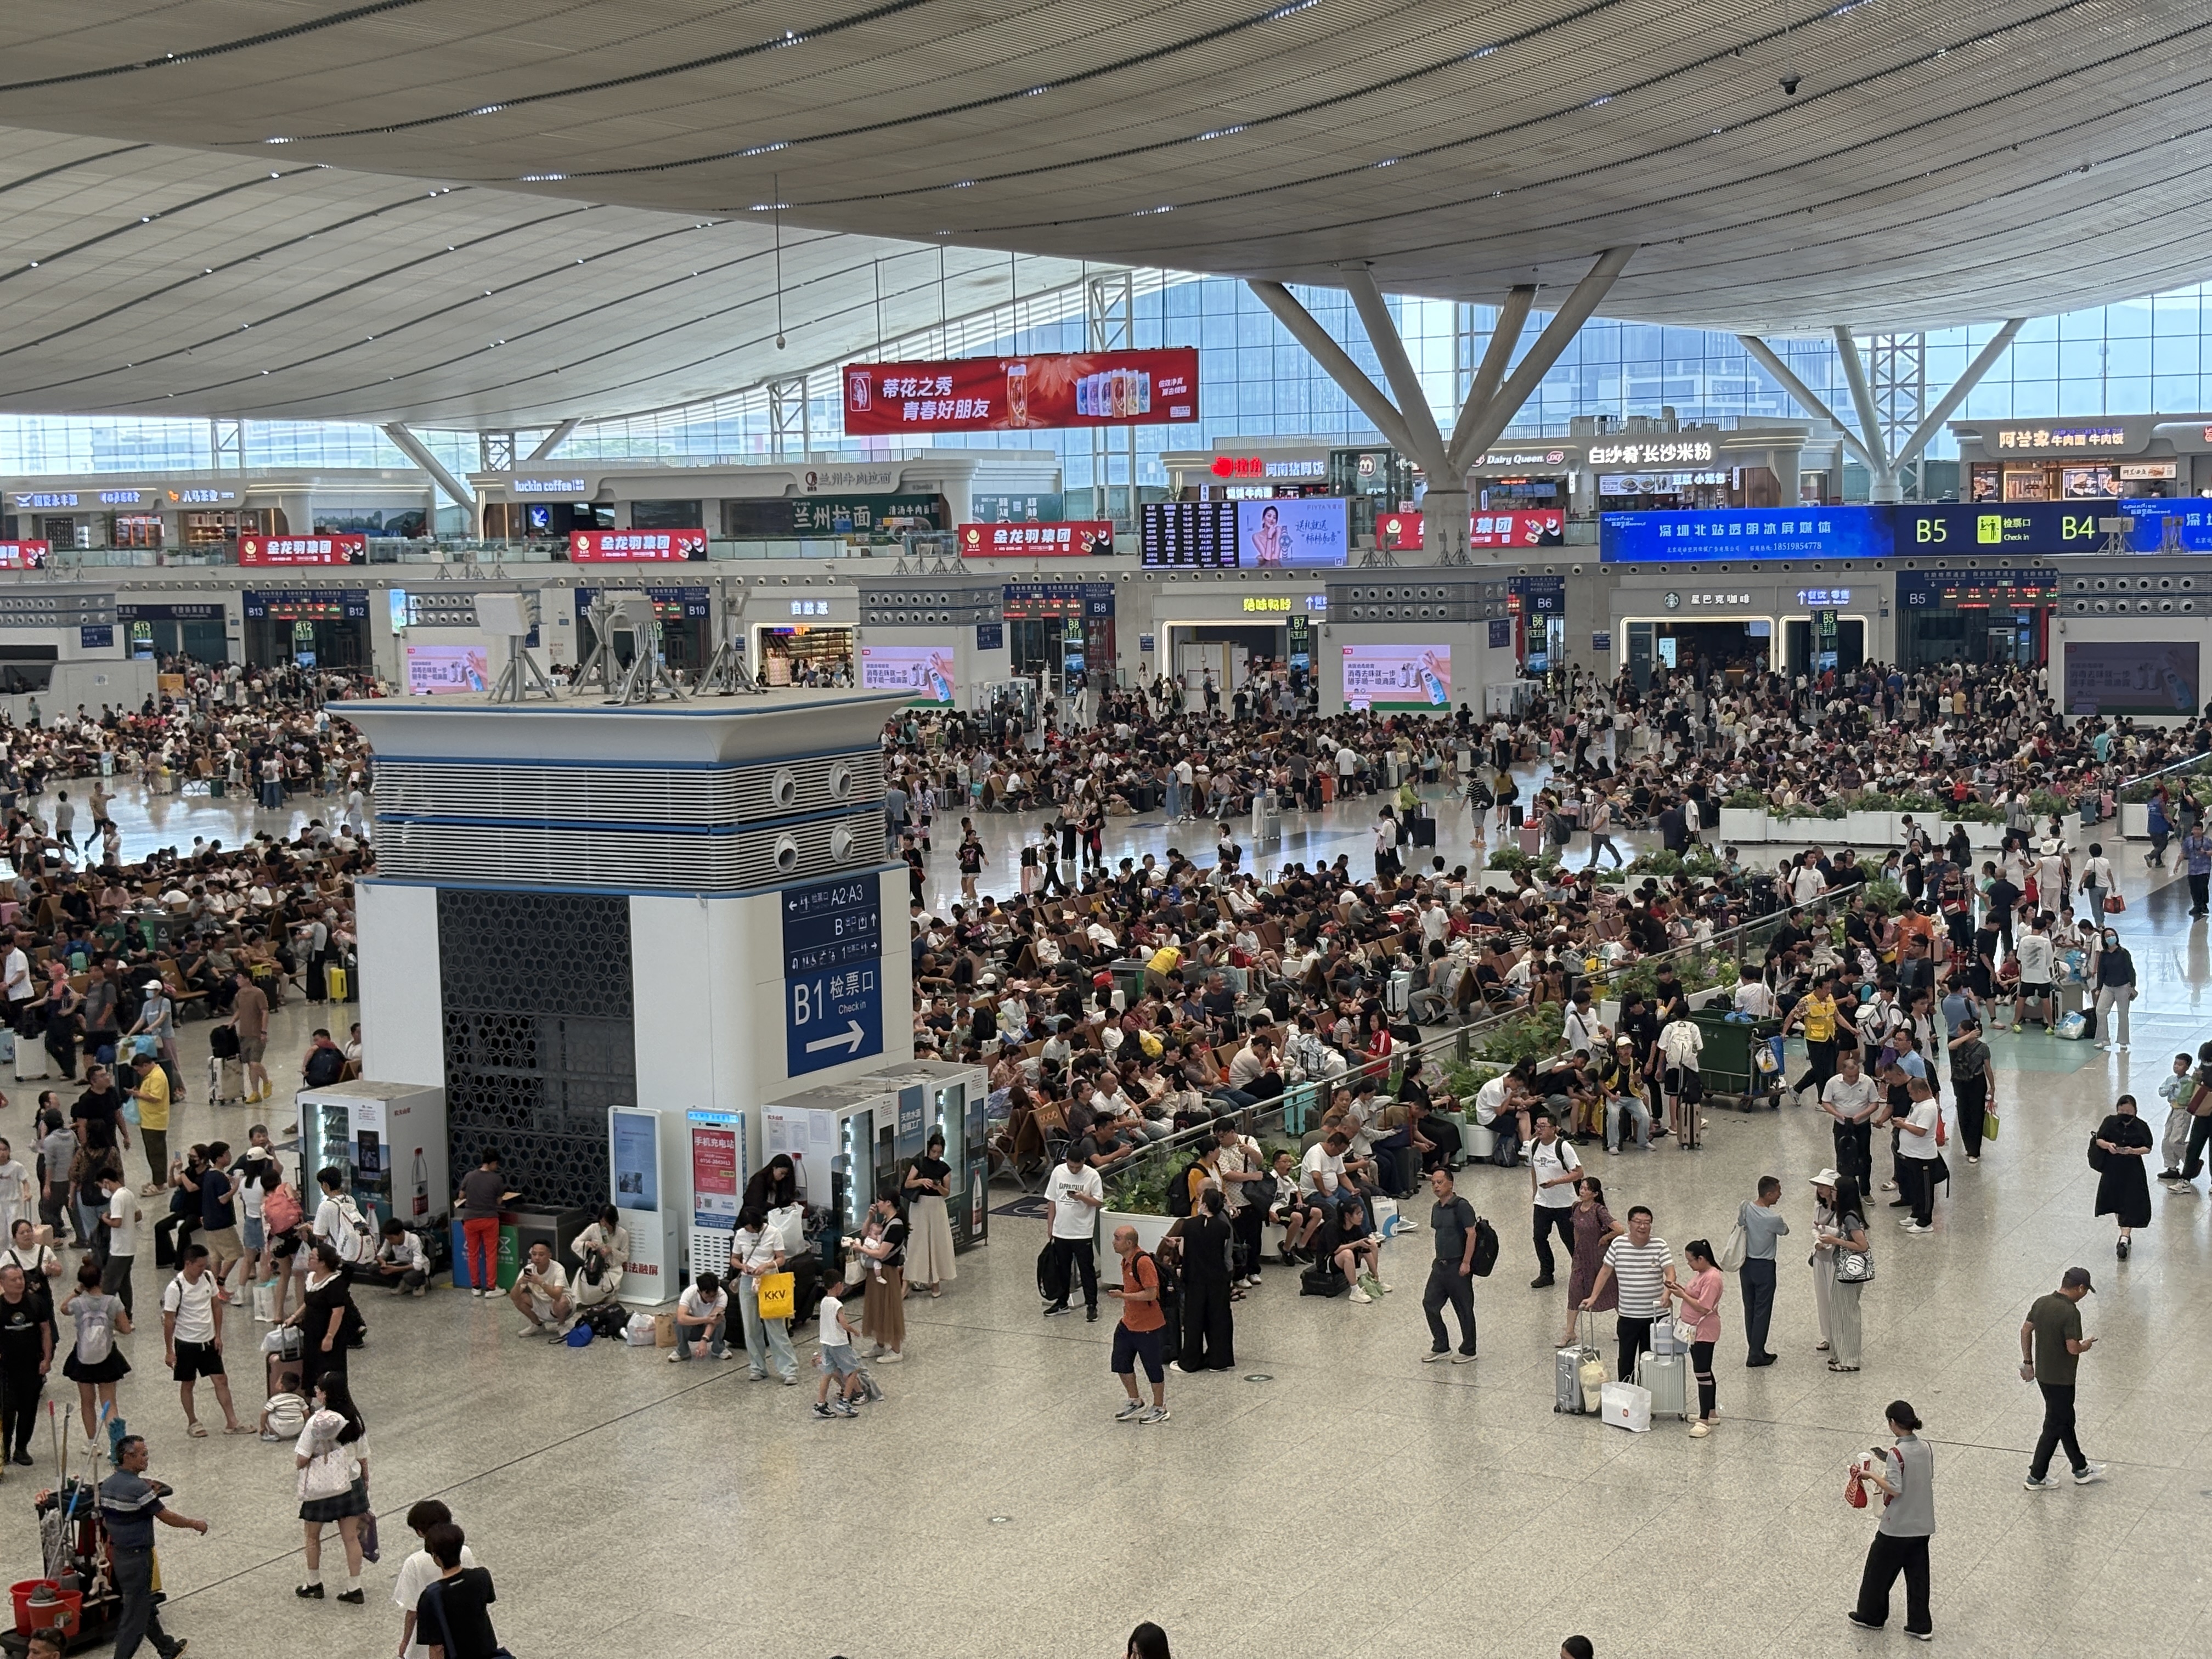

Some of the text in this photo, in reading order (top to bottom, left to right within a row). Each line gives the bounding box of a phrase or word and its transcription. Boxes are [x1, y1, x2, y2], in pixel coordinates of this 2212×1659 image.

[883, 376, 953, 399] 蒂花之秀
[903, 398, 991, 421] 青春好朋友
[1642, 442, 1711, 462] 长沙米粉
[1487, 455, 1543, 465] Dairy Queen
[819, 471, 891, 487] 兰州牛肉拉面
[514, 479, 572, 492] luckin coffee
[2004, 517, 2031, 528] 检票口
[2062, 516, 2096, 540] B4
[1659, 521, 1831, 537] 深圳北站透明冰屏媒体
[1916, 519, 1947, 543] B5
[994, 528, 1071, 544] 金龙羽集团
[2004, 533, 2030, 541] Check in
[267, 540, 332, 555] 金龙羽集团
[601, 535, 671, 550] 金龙羽集团
[1774, 541, 1822, 551] 18519854778
[1243, 597, 1291, 612] 绝味鸭脖
[1538, 598, 1552, 608] B6
[1691, 594, 1751, 605] 星巴克咖啡
[1910, 594, 1926, 605] B5
[249, 607, 263, 616] B13
[349, 607, 364, 616] B12
[690, 606, 706, 616] B10
[1094, 603, 1107, 613] B8
[1294, 618, 1305, 628] B7
[1532, 617, 1544, 627] B6
[1823, 613, 1834, 623] B5
[134, 623, 150, 631] B13
[296, 622, 313, 631] B12
[1068, 620, 1080, 629] B8
[835, 918, 843, 936] B
[794, 970, 874, 1026] B1 检票口
[695, 1136, 735, 1149] 手机充电站
[764, 1289, 786, 1300] KKV
